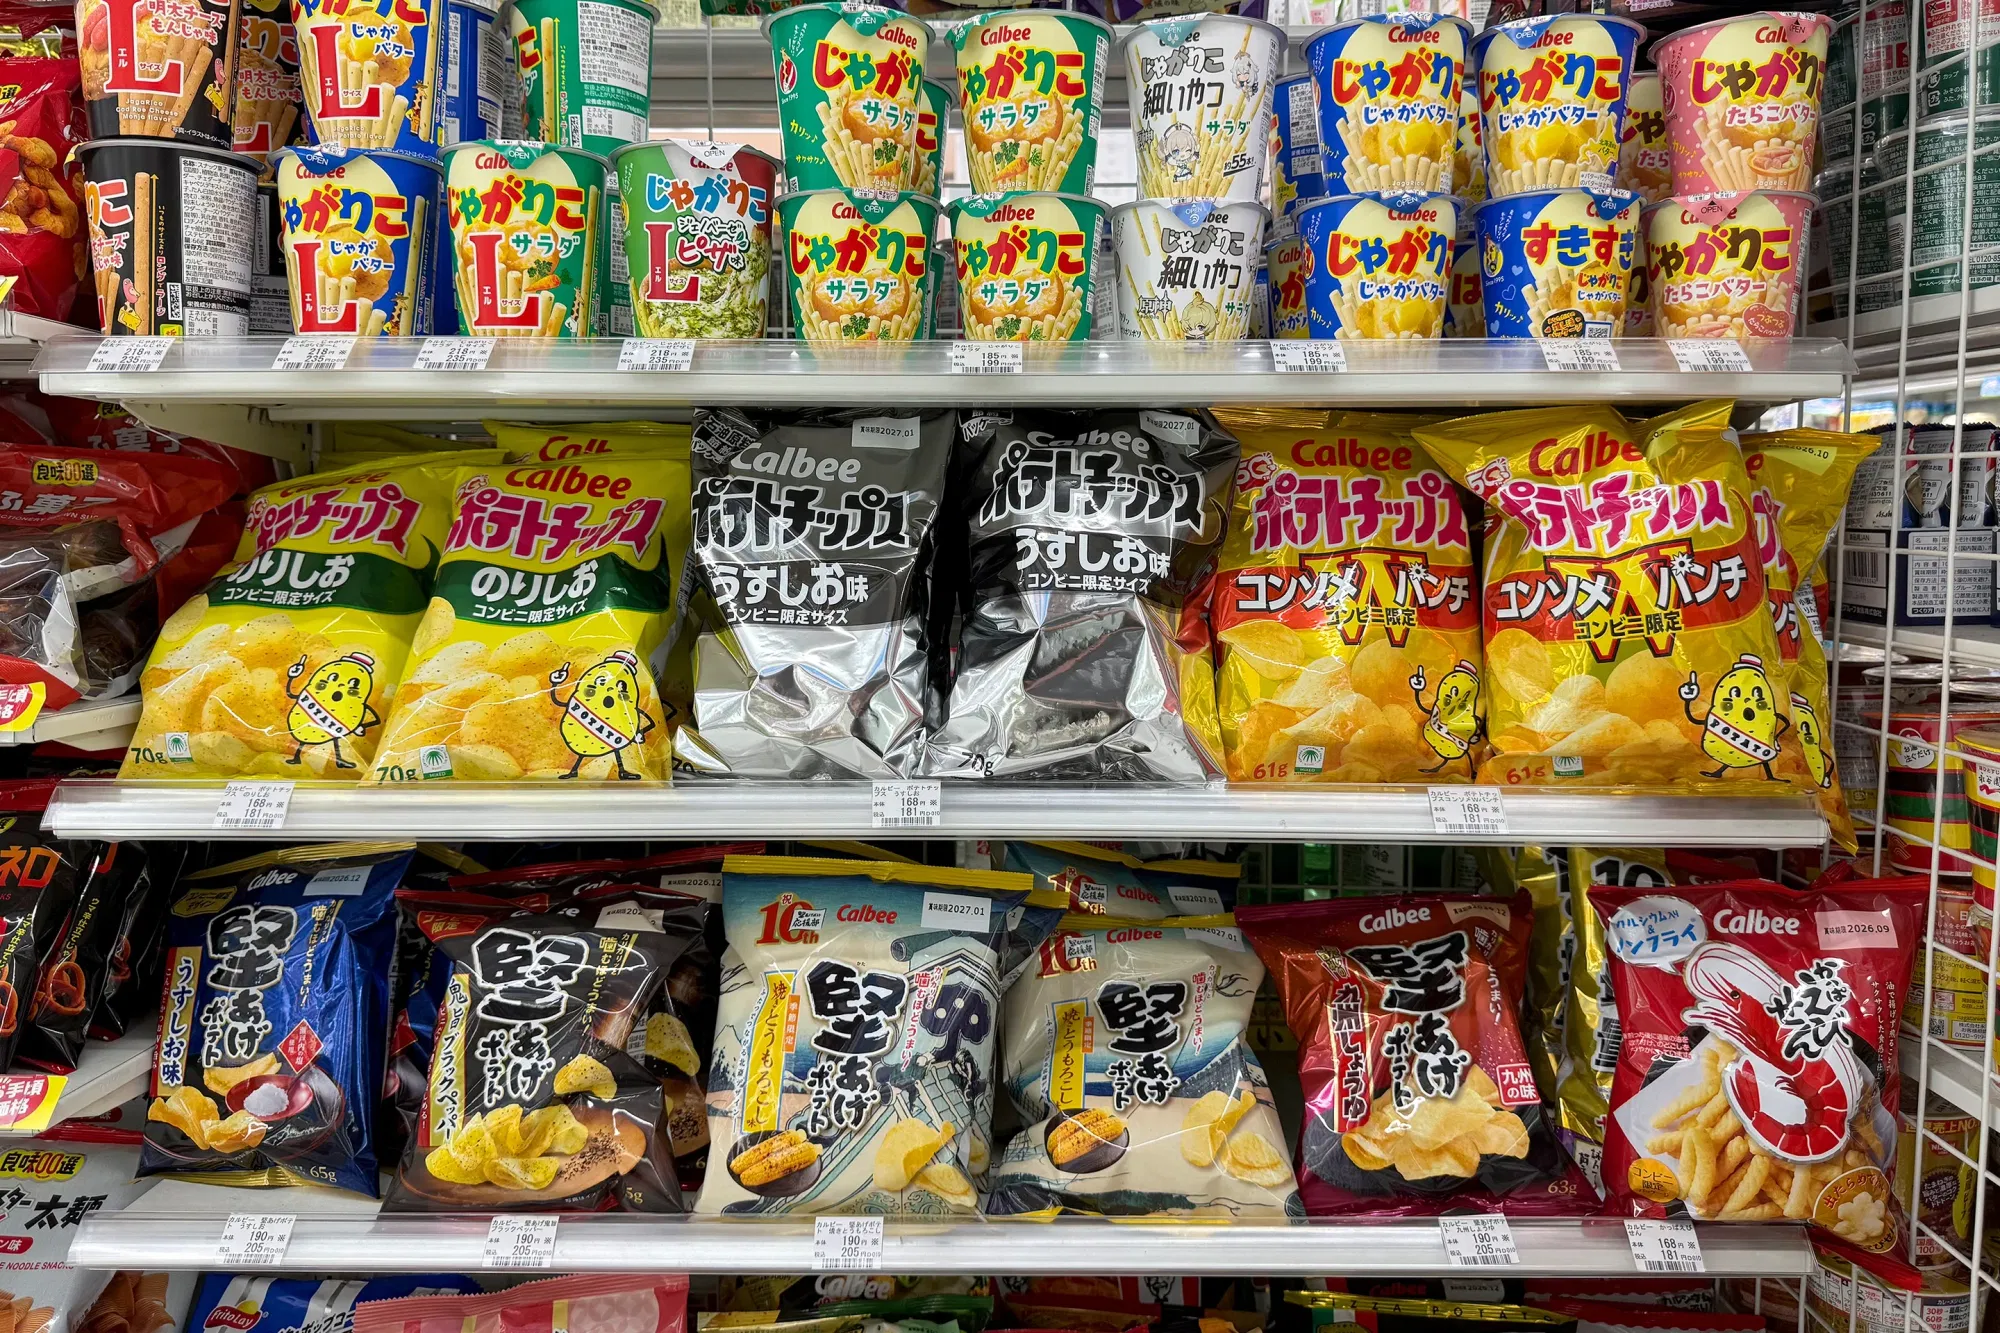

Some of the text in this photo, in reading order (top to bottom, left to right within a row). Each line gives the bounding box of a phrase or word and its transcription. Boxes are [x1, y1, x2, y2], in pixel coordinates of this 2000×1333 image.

[147, 0, 226, 29] 明太チーズ
[151, 18, 219, 45] もんじゃ味
[352, 24, 398, 39] じゃが
[876, 23, 918, 50] Calbee
[980, 25, 1032, 46] Calbee
[1163, 26, 1182, 34] OPEN
[1515, 29, 1537, 39] OPEN
[117, 48, 128, 68] エル
[374, 43, 415, 58] バター
[139, 62, 162, 71] サイズ
[311, 25, 382, 119] L
[1141, 46, 1225, 83] じゃがりこ
[325, 77, 334, 96] エル
[957, 45, 1087, 110] じゃがりこ
[1479, 49, 1623, 114] じゃがりこ
[125, 99, 163, 107] JagaRico
[342, 89, 362, 97] サイズ
[1142, 78, 1225, 120] 細いやつ
[862, 100, 916, 132] サラダ
[979, 102, 1049, 134] サラダ
[1363, 103, 1454, 125] じゃがバター
[1498, 105, 1599, 134] じゃがバター
[1726, 104, 1816, 126] たらこバター
[1206, 120, 1250, 137] サラダ
[306, 153, 328, 166] OPEN
[508, 151, 530, 160] OPEN
[447, 173, 586, 233] じゃがりこ
[646, 173, 767, 224] じゃがりこ
[864, 205, 884, 214] OPEN
[968, 202, 989, 211] OPEN
[1396, 196, 1419, 208] OPEN
[1601, 201, 1617, 209] OPEN
[1700, 205, 1723, 214] OPEN
[1185, 207, 1204, 216] OPEN
[678, 218, 743, 234] ジェノベーゼ
[330, 240, 377, 255] じゃが
[511, 234, 580, 258] サラダ
[790, 222, 927, 278] じゃがりこ
[953, 223, 1086, 281] じゃがりこ
[1160, 225, 1246, 256] じゃがりこ
[1645, 224, 1793, 281] じゃがりこ
[644, 222, 701, 302] L
[678, 235, 745, 271] ピザ味
[351, 258, 395, 273] バター
[654, 266, 663, 283] エル
[1156, 255, 1242, 290] 細いやつ
[293, 241, 359, 334] L
[468, 233, 541, 329] L
[826, 280, 898, 303] サラダ
[1359, 280, 1446, 302] じゃがバター
[1577, 271, 1623, 290] じゃがりこ
[1664, 278, 1767, 304] たらこバター
[304, 293, 313, 312] エル
[482, 286, 492, 305] エル
[502, 299, 521, 307] サイズ
[980, 281, 1049, 307] サラダ
[1577, 289, 1622, 302] じゃがバター
[321, 305, 338, 313] サイズ
[1137, 290, 1173, 323] 原神
[1756, 312, 1784, 329] つぶつぶ
[1026, 429, 1151, 459] Calbee
[1290, 438, 1413, 472] Calbee
[731, 442, 862, 483] Calbee
[505, 466, 632, 500] Calbee
[979, 441, 1206, 538] ポテトチップス
[256, 483, 423, 559] ポテトチップス
[691, 475, 912, 555] ポテトチップス
[1251, 469, 1468, 555] ポテトチップス
[444, 488, 667, 563] ポテトチップス
[1015, 528, 1171, 579] うすしお味
[470, 560, 600, 608] のりしお
[708, 562, 869, 607] うすしお味
[1027, 572, 1152, 595] コンビニ限定サイズ
[1236, 566, 1358, 614] コンソメ
[1393, 562, 1472, 616] パンチ
[1495, 574, 1615, 622] コンソメ
[1654, 552, 1748, 612] パンチ
[222, 587, 337, 606] コンビニ限定サイズ
[472, 598, 589, 624] コンビニ限定サイズ
[726, 606, 850, 625] コンビニ限定サイズ
[1325, 608, 1417, 629] コンビニ限定
[1573, 610, 1685, 641] コンビニ限定
[301, 693, 350, 736] POTATO
[570, 700, 623, 747] POTATO
[1708, 717, 1772, 758] POTATO
[131, 746, 168, 765] 70g
[1252, 761, 1288, 780] 61g
[1505, 767, 1547, 784] 61g
[900, 797, 926, 806] 168円
[1461, 803, 1488, 813] 168円
[247, 868, 299, 892] Calbee
[781, 894, 794, 905] 祝
[928, 901, 986, 917] 賞味期限2027.01
[791, 918, 821, 930] 応援部
[836, 903, 898, 925] Calbee
[1357, 906, 1432, 934] Calbee
[1616, 909, 1679, 930] カルシウム入り
[1713, 908, 1800, 936] Calbee
[1106, 927, 1163, 945] Calbee
[1617, 923, 1698, 956] ノンフライ
[1647, 924, 1655, 934] &
[1824, 924, 1891, 936] 賞味期限2026.09
[299, 904, 329, 1009] 噛むほどうまい!
[582, 936, 618, 1034] 噛むほどうまい!
[162, 957, 196, 1087] うすしお味
[200, 996, 230, 1068] ポテト
[785, 1002, 799, 1046] 季節限定
[901, 972, 931, 1071] 噛むほどうまい!
[756, 979, 787, 1125] 焼きとうもろこし
[806, 958, 908, 1135] 堅あげ ポテト
[1332, 983, 1367, 1120] 九州しょうゆ
[436, 977, 470, 1141] 鬼旨ブラックペッパー
[476, 1028, 509, 1108] ポテト
[1107, 1060, 1132, 1112] ポテト
[1501, 1069, 1533, 1085] 九州
[1507, 1085, 1537, 1099] の味
[1, 1150, 81, 1176] 良味00選
[310, 1164, 337, 1183] 65g
[1547, 1181, 1578, 1196] 63g
[250, 1230, 275, 1241] 190円
[515, 1233, 540, 1244] 190円
[843, 1235, 867, 1246] 190円
[1472, 1232, 1498, 1243] 190円
[1658, 1238, 1684, 1248] 168円
[6, 1262, 40, 1271] NOODLE
[814, 1275, 892, 1300] Calbee
[210, 1305, 254, 1329] FritoLay
